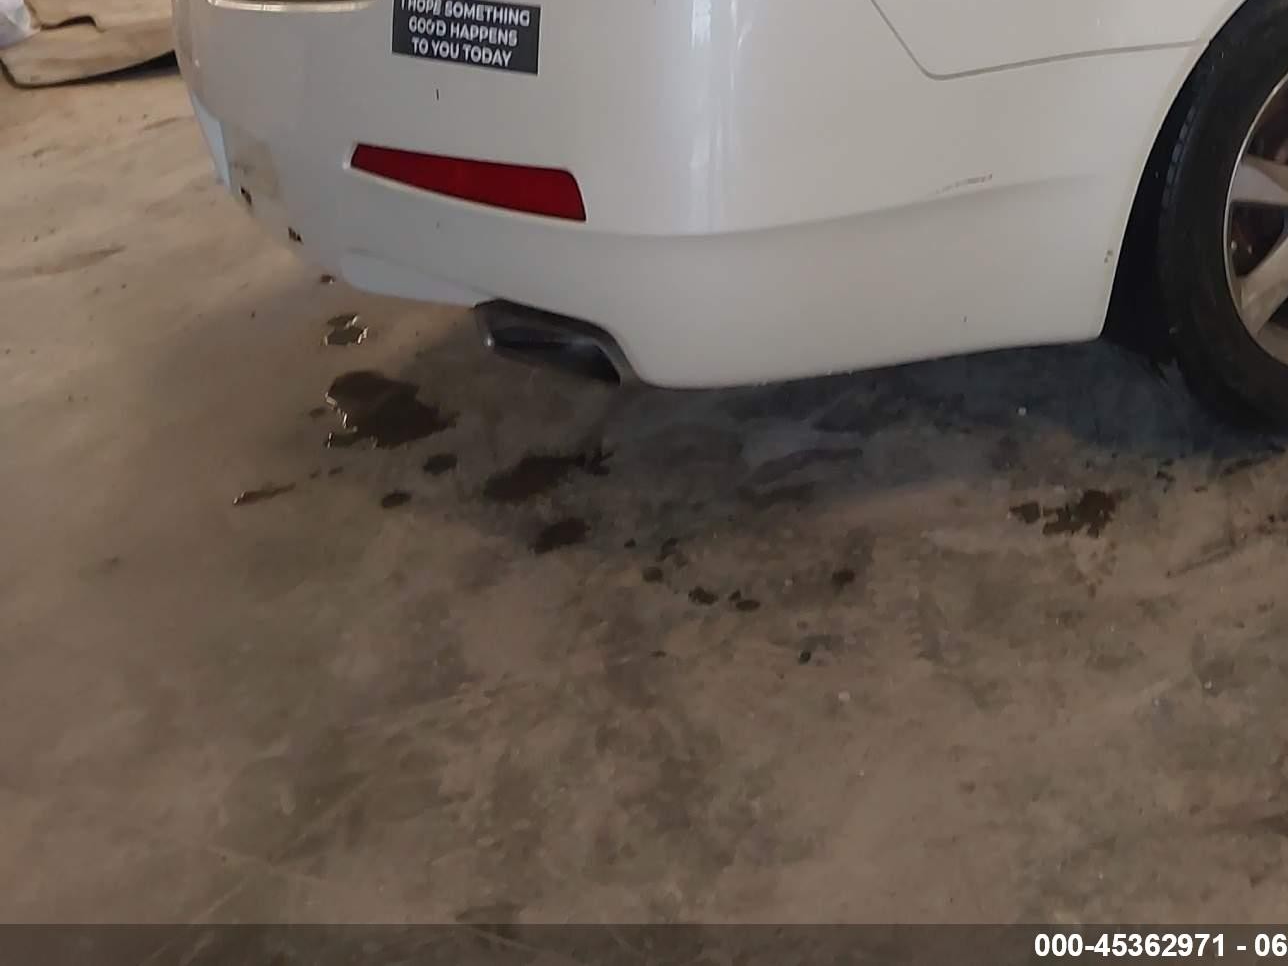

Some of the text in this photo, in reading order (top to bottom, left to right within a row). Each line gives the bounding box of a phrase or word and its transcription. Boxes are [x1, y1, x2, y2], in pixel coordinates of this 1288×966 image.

[444, 0, 530, 27] SOMETHING
[408, 16, 518, 47] GOOD HAPPENS
[411, 36, 512, 67] TO YOU TODAY
